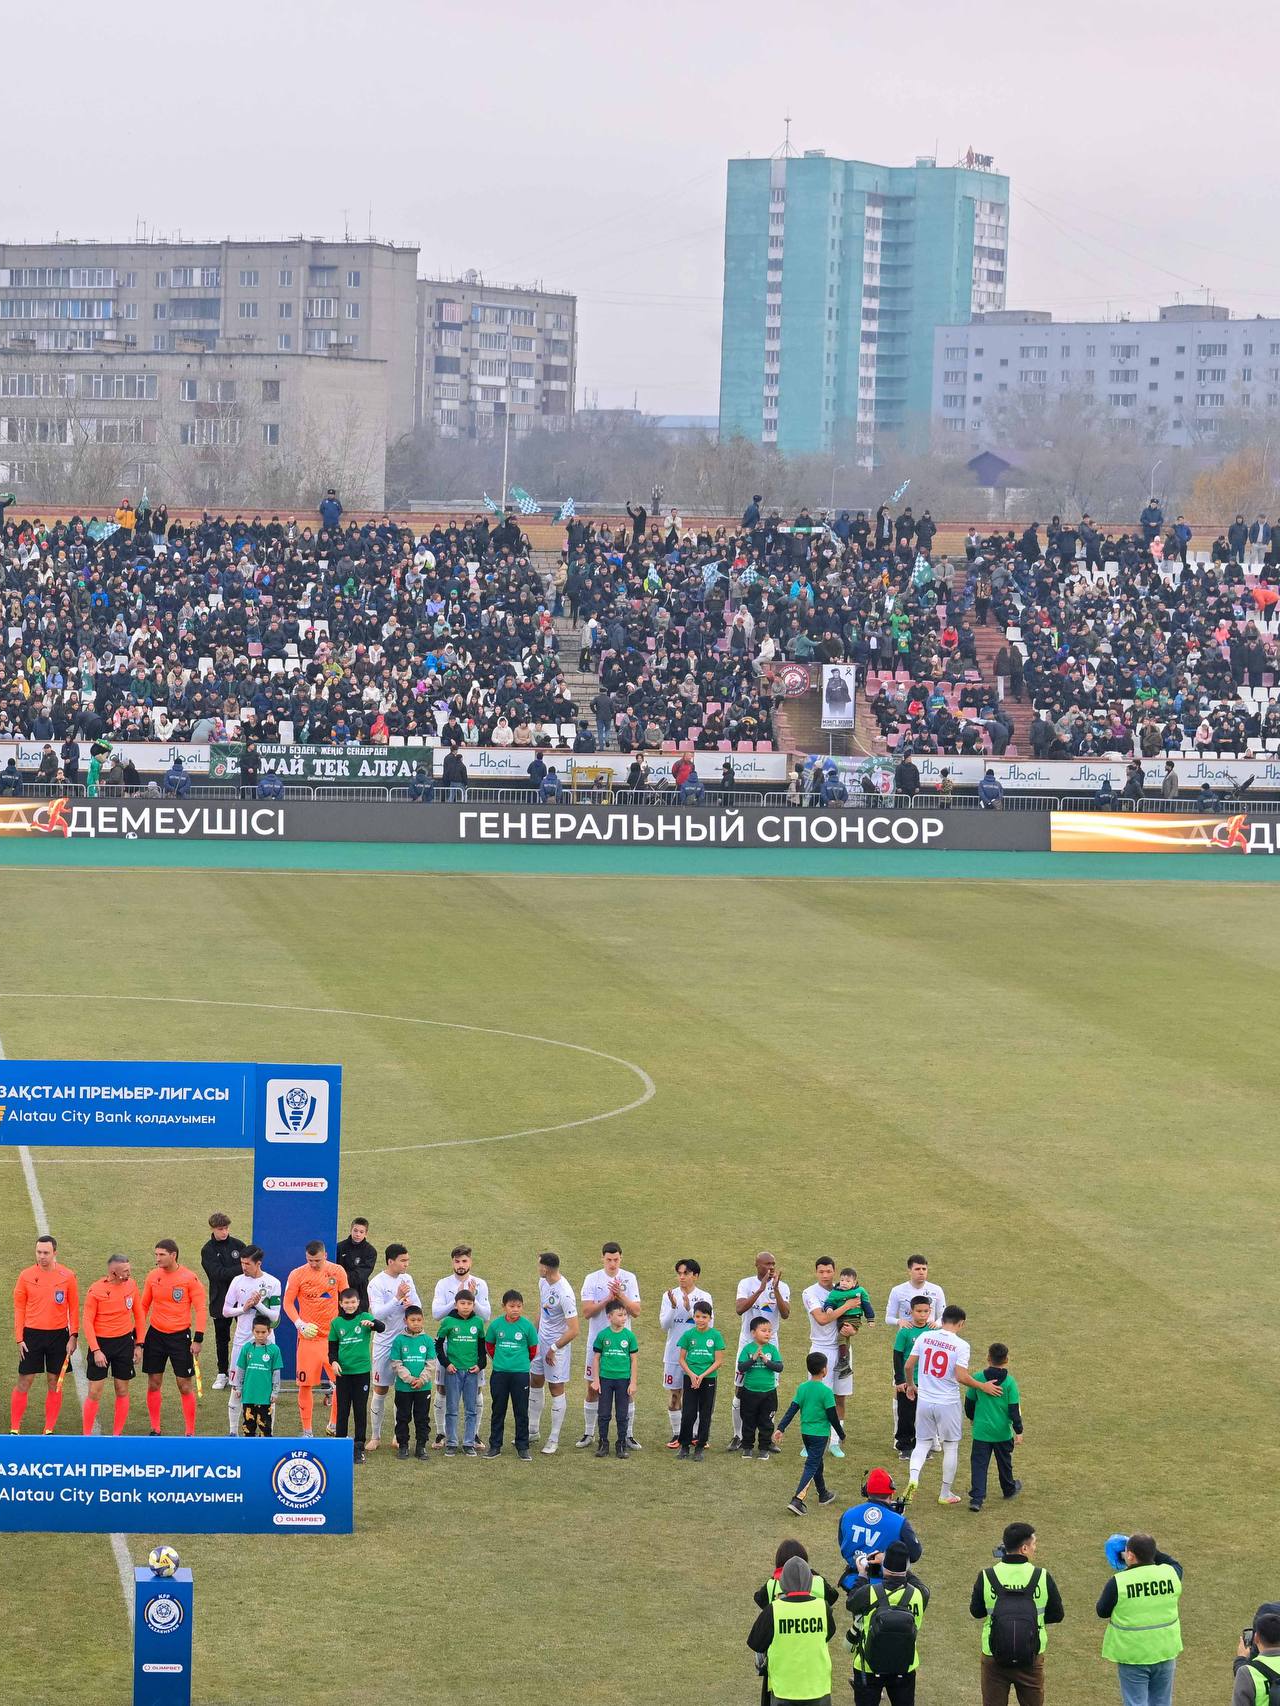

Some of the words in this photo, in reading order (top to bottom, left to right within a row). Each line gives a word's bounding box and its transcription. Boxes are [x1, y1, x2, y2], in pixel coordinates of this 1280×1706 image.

[256, 745, 286, 755] ҚОЛДАУ
[321, 747, 344, 756] ЖЕҢІС
[347, 747, 388, 756] СЕНДЕРДЕН
[313, 759, 350, 776] ТЕК
[358, 760, 418, 777] АЛҒА!
[470, 752, 518, 770] Abai
[1001, 764, 1048, 783] Abai
[66, 806, 285, 837] ДЕМЕУШІСІ
[460, 810, 745, 843] ГЕНЕРАЛЬНЫЙ
[757, 816, 944, 845] СПОНСОР
[80, 1086, 230, 1102] ПРЕМЬЕР-ЛИГАСЫ
[8, 1110, 57, 1123] Alatau
[61, 1111, 91, 1127] City
[95, 1111, 132, 1124] Bank
[135, 1114, 216, 1126] ҚОЛДАУЫМЕН
[278, 1180, 325, 1188] OLIMPBET
[923, 1347, 949, 1379] 19
[90, 1464, 242, 1480] ПРЕМЬЕР-ЛИГАСЫ
[59, 1488, 94, 1506] City
[99, 1489, 142, 1503] Bank
[147, 1491, 244, 1504] ҚОЛДАУЫМЕН
[277, 1494, 322, 1509] KAZAKHSTAN
[851, 1524, 881, 1547] TV
[1127, 1580, 1175, 1599] ПРЕССА
[778, 1618, 824, 1634] ПРЕССА
